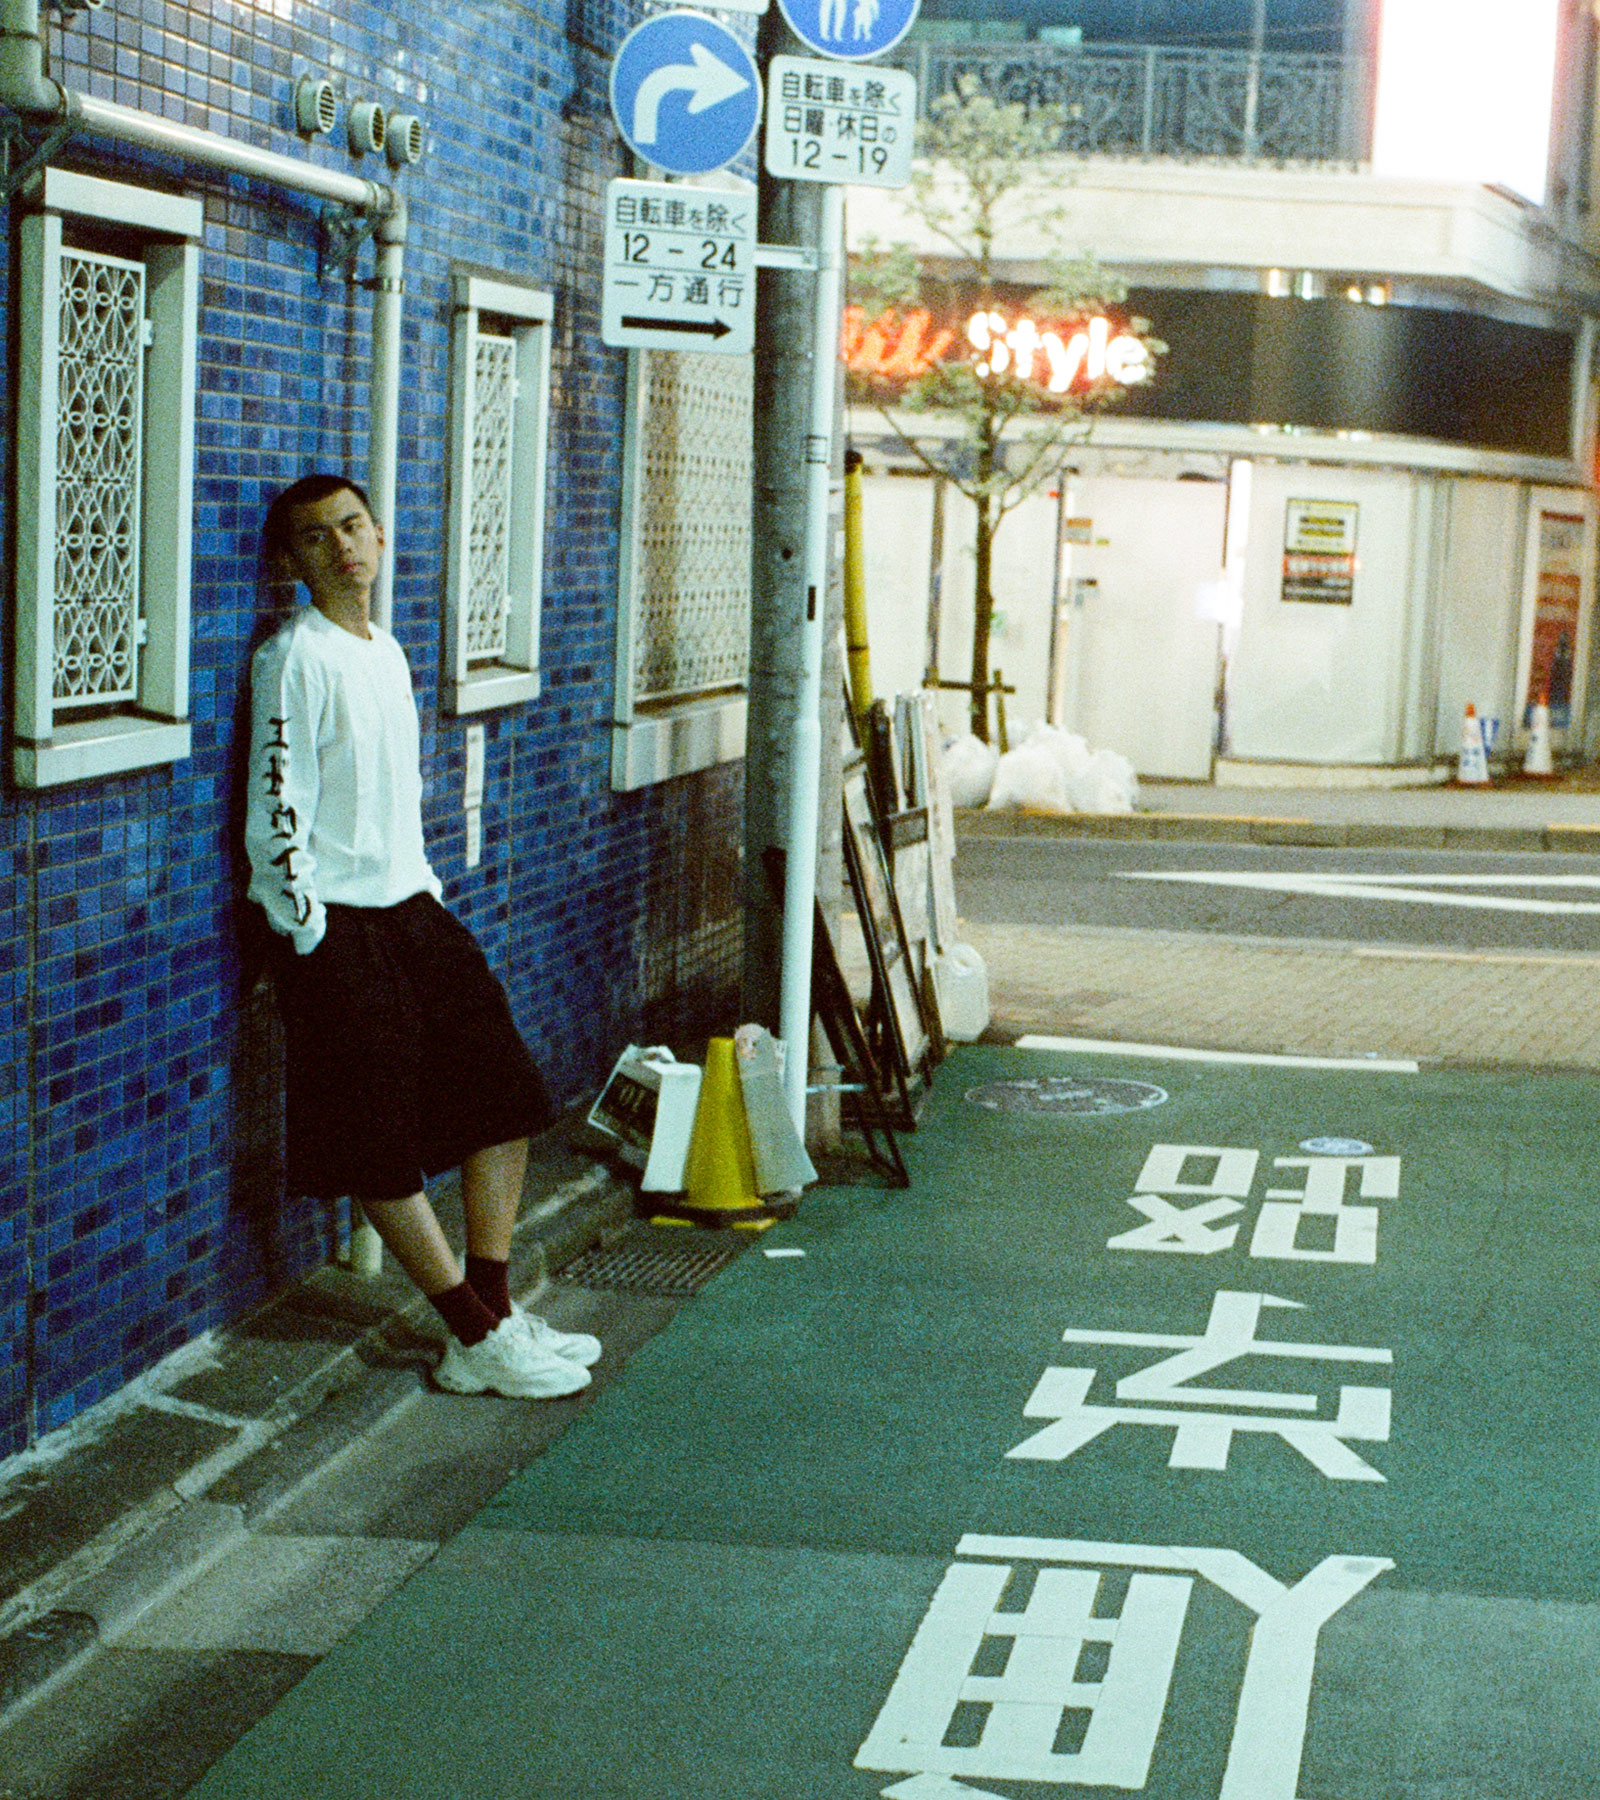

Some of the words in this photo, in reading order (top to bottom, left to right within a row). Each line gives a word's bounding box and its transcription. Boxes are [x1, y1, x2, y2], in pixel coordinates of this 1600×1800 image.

[782, 71, 900, 111] 自転車を除く
[615, 196, 748, 233] 自転車を除く
[613, 273, 745, 308] 一方通行
[967, 311, 1149, 392] Style
